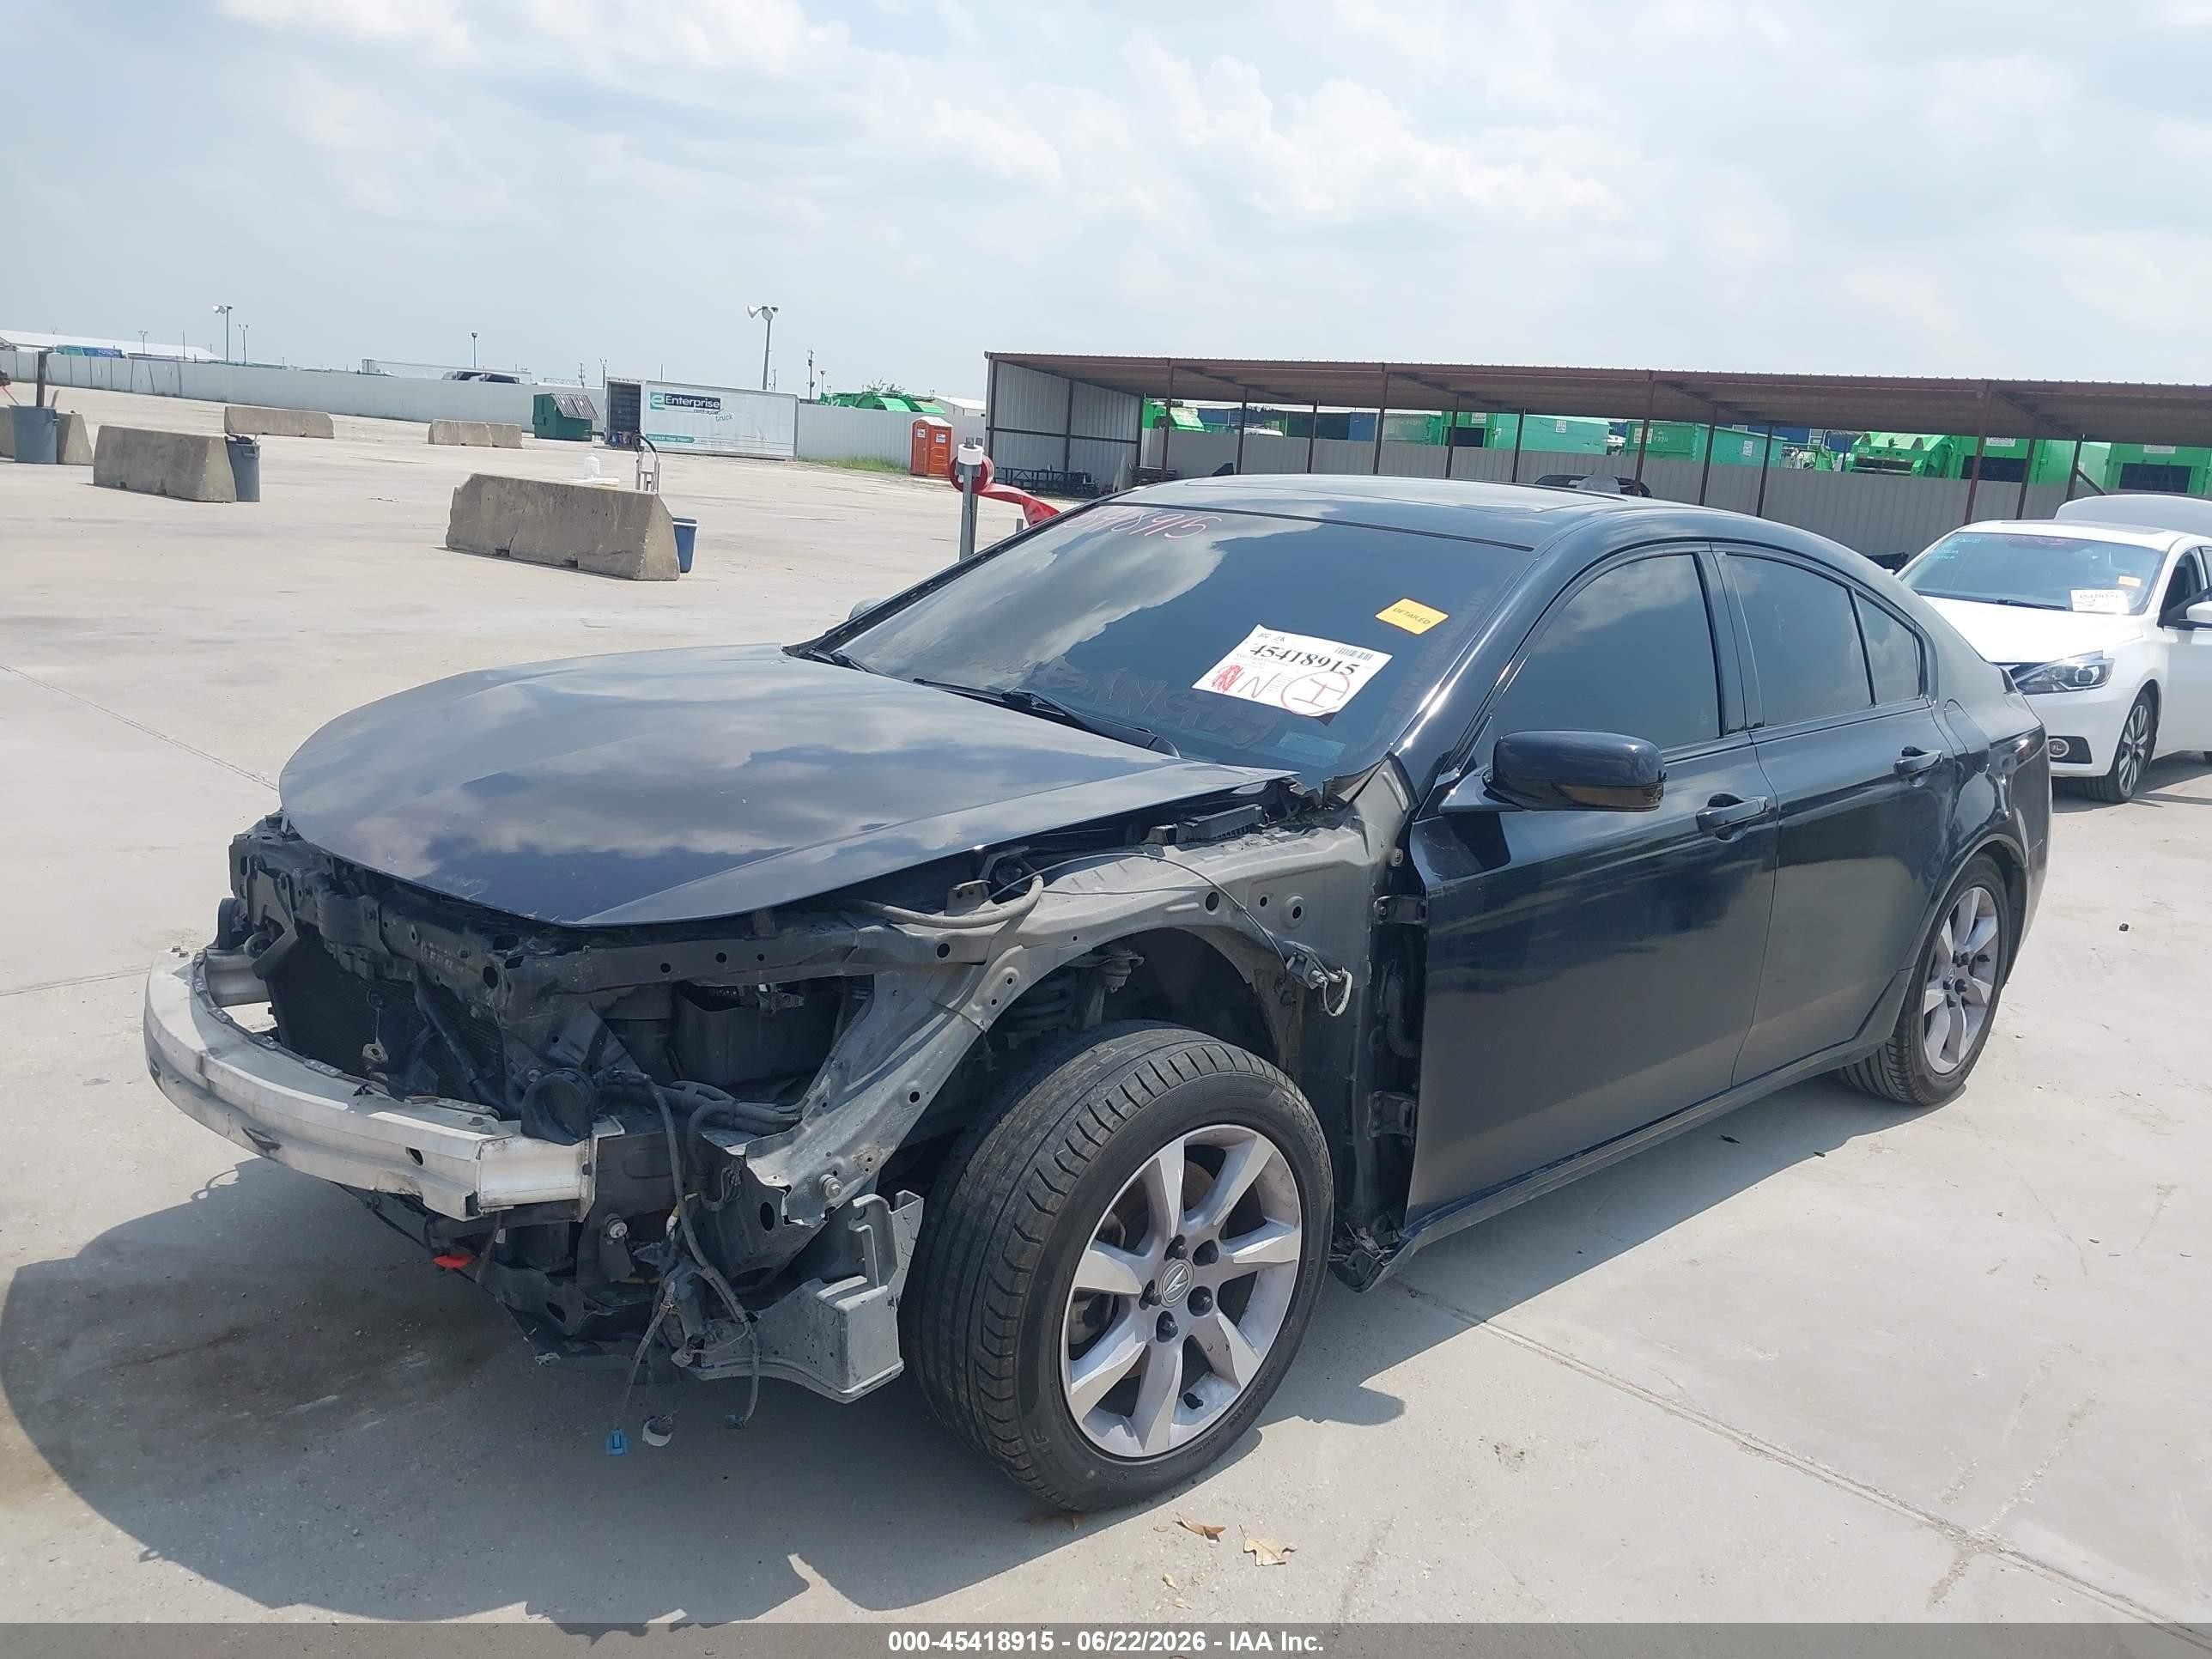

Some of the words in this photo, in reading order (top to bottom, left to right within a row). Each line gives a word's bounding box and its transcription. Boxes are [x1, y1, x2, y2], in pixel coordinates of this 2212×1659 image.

[665, 396, 720, 408] Enterprise
[1393, 607, 1431, 625] DETAILED
[1250, 644, 1360, 676] 45418915
